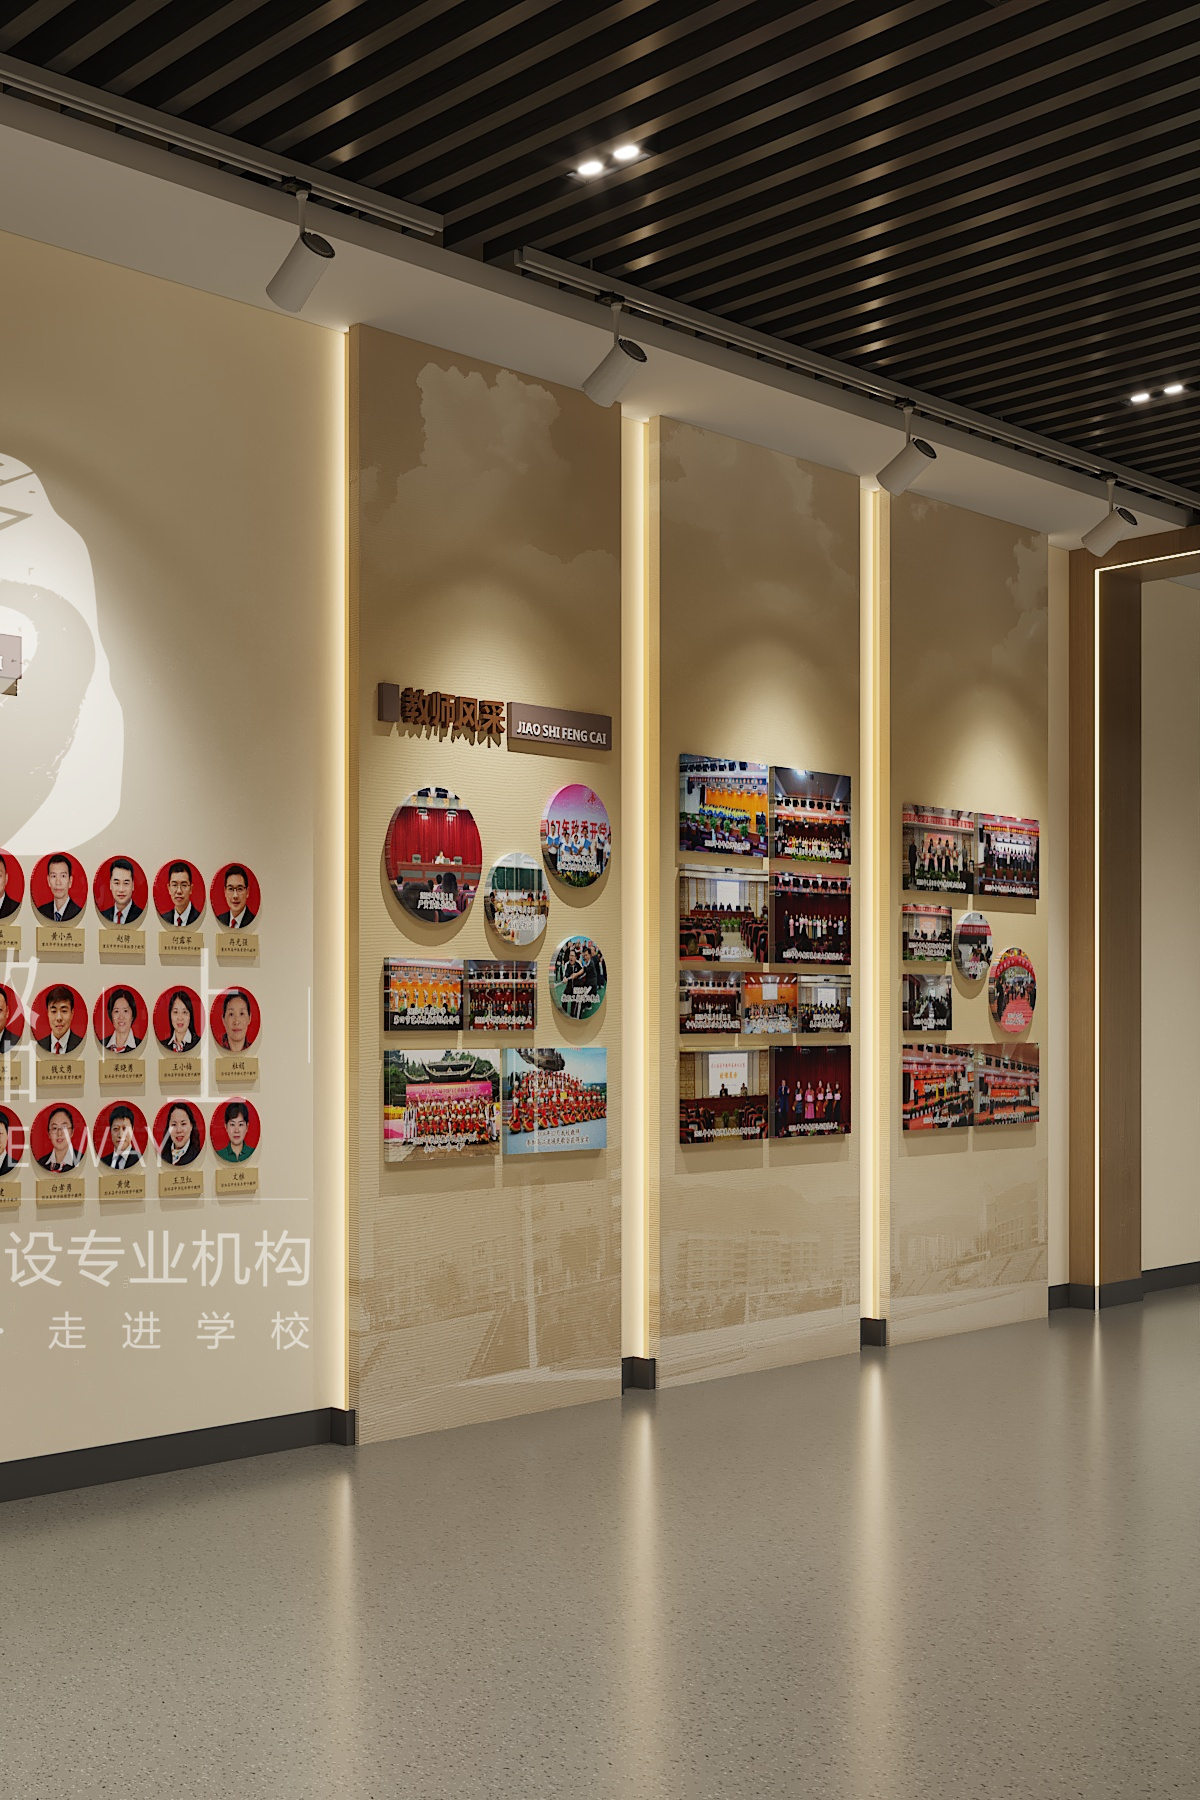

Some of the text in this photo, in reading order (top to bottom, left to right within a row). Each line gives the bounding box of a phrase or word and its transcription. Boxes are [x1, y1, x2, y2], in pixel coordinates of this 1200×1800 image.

[401, 687, 505, 734] 教师风采
[517, 721, 607, 745] JIAO SHI FENG CAI
